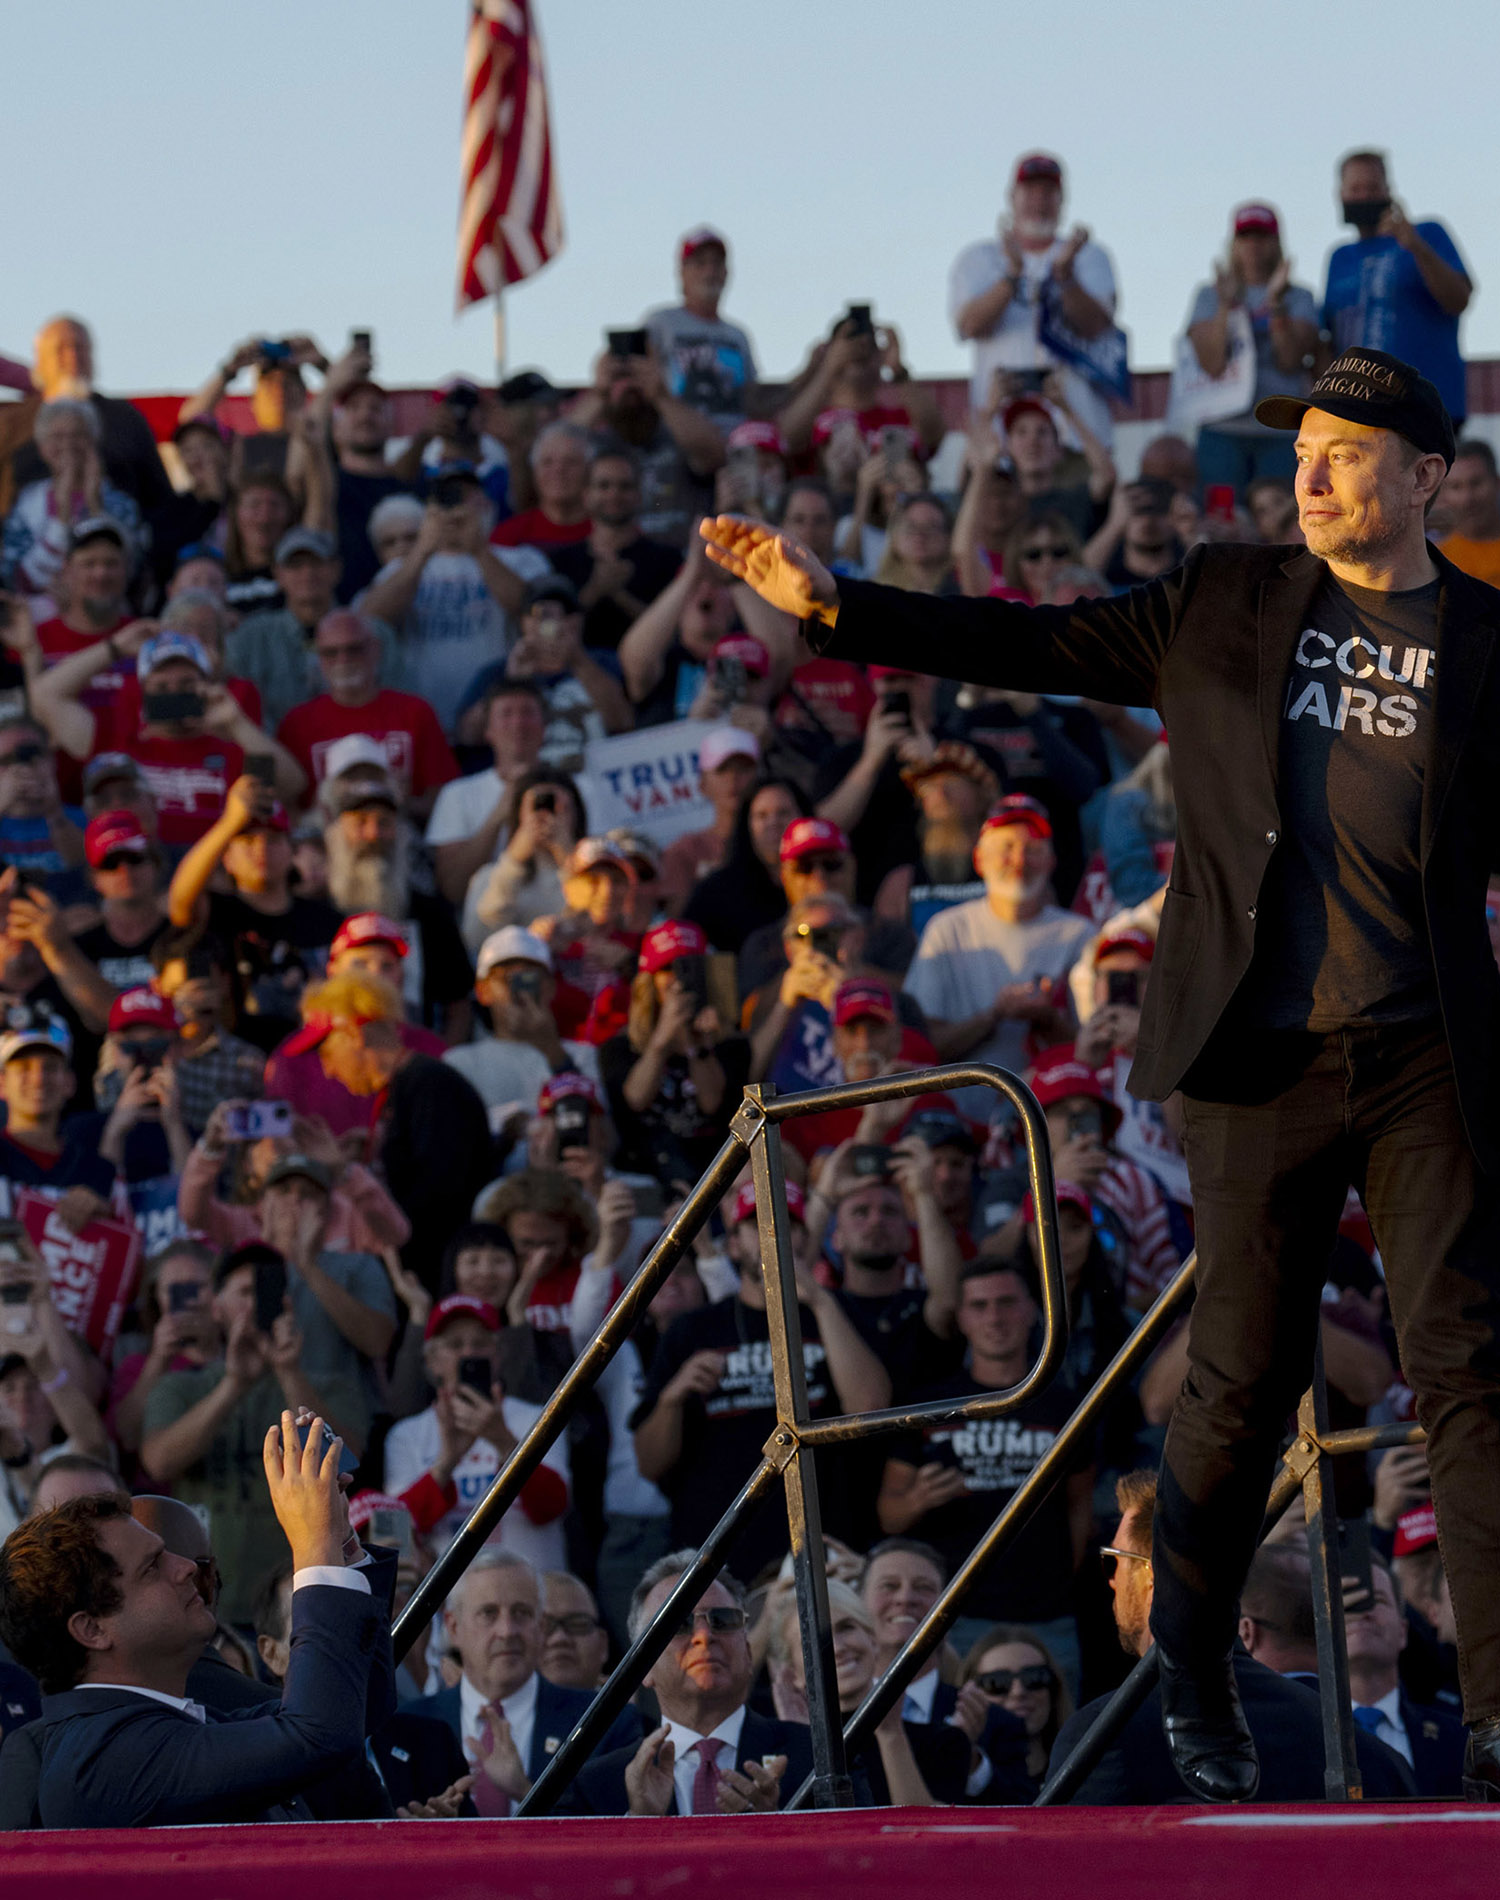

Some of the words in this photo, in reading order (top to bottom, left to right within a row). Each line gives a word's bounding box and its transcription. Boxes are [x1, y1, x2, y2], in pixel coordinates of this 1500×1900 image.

[1326, 377, 1376, 400] AGAIN
[1331, 357, 1396, 387] AMERICA
[1295, 628, 1436, 688] CCUP
[1284, 677, 1418, 738] ARS
[603, 751, 699, 794] TRU
[625, 782, 700, 813] VAN
[726, 1343, 826, 1376] RUP
